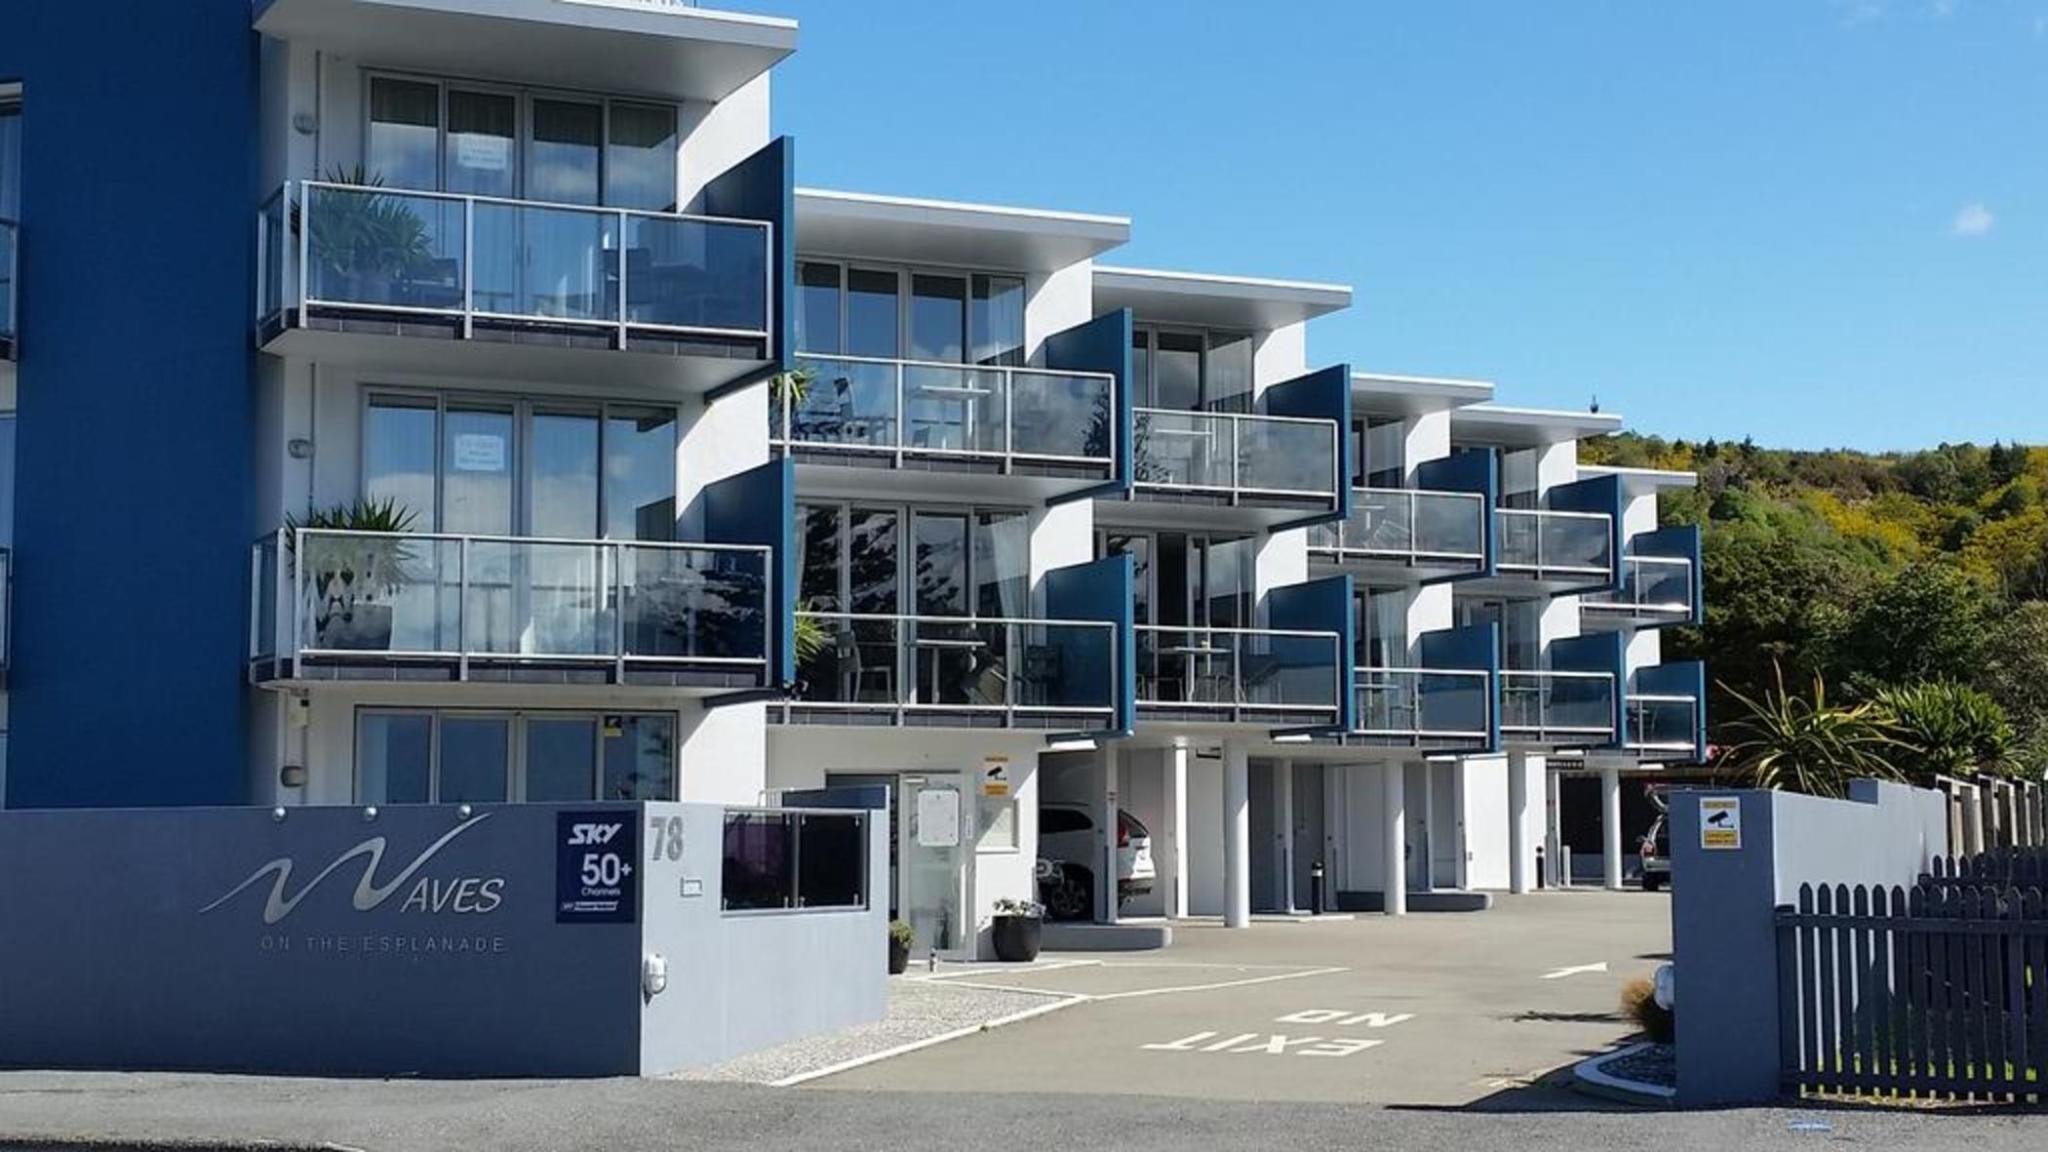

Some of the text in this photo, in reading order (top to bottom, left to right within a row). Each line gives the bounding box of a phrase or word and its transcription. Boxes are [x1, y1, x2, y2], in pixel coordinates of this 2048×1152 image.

[567, 823, 623, 845] SKY
[650, 815, 684, 862] 78
[580, 852, 633, 886] 50+
[580, 886, 621, 897] Channels
[260, 936, 504, 951] ON THE ESPLANADE
[1272, 1008, 1417, 1028] NO
[1139, 1031, 1386, 1057] EXIT
